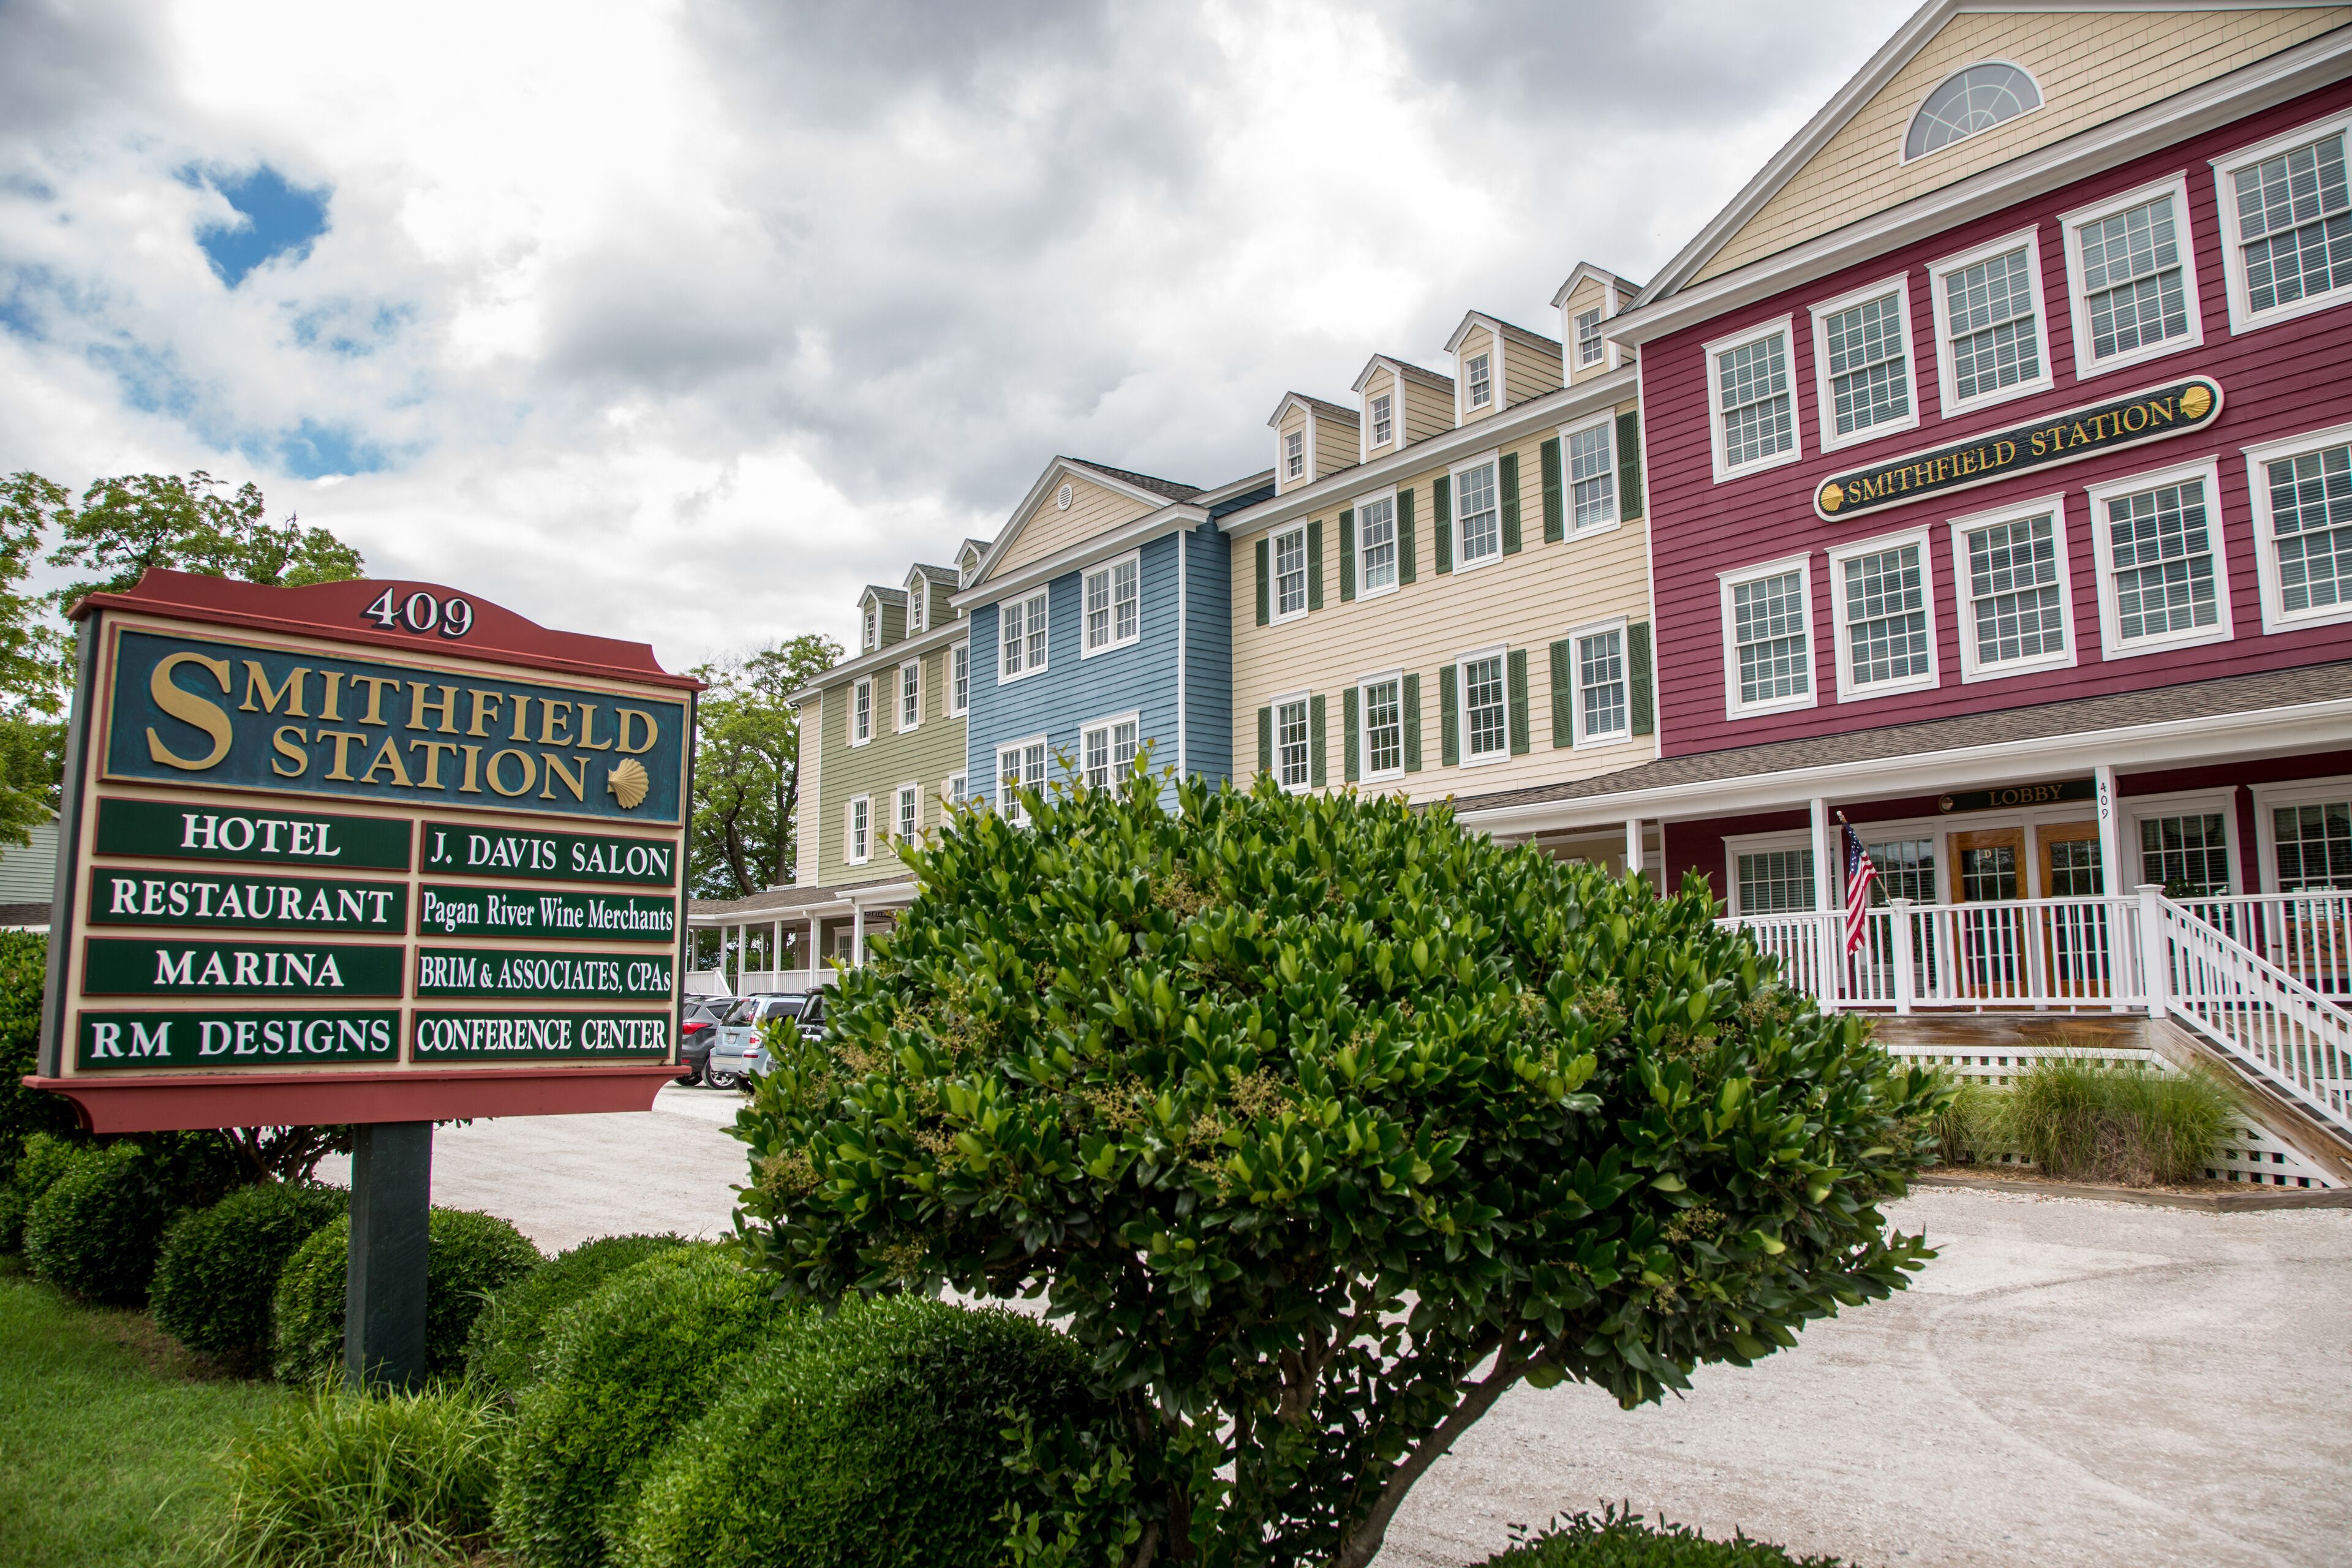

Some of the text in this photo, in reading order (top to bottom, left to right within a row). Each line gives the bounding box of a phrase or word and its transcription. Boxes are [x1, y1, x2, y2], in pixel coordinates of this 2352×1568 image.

[1849, 396, 2174, 503] SMITHFIELD STATION
[365, 587, 473, 637] 409
[146, 652, 659, 771] SMITHFIELD
[271, 725, 590, 802] STATION
[1988, 784, 2064, 807] LOBBY
[181, 813, 341, 856] HOTEL
[431, 832, 670, 875] J. DAVIS SALON
[110, 878, 394, 923] RESTAURANT
[423, 892, 673, 932] Pagan River Wine Merchants
[154, 949, 344, 987] MARINA
[420, 956, 477, 987] BRIM
[480, 963, 494, 988] &
[497, 958, 623, 993] ASSOCIATES,
[91, 1019, 391, 1058] RM DESIGNS
[417, 1019, 666, 1052] CONFERENCE CENTER
